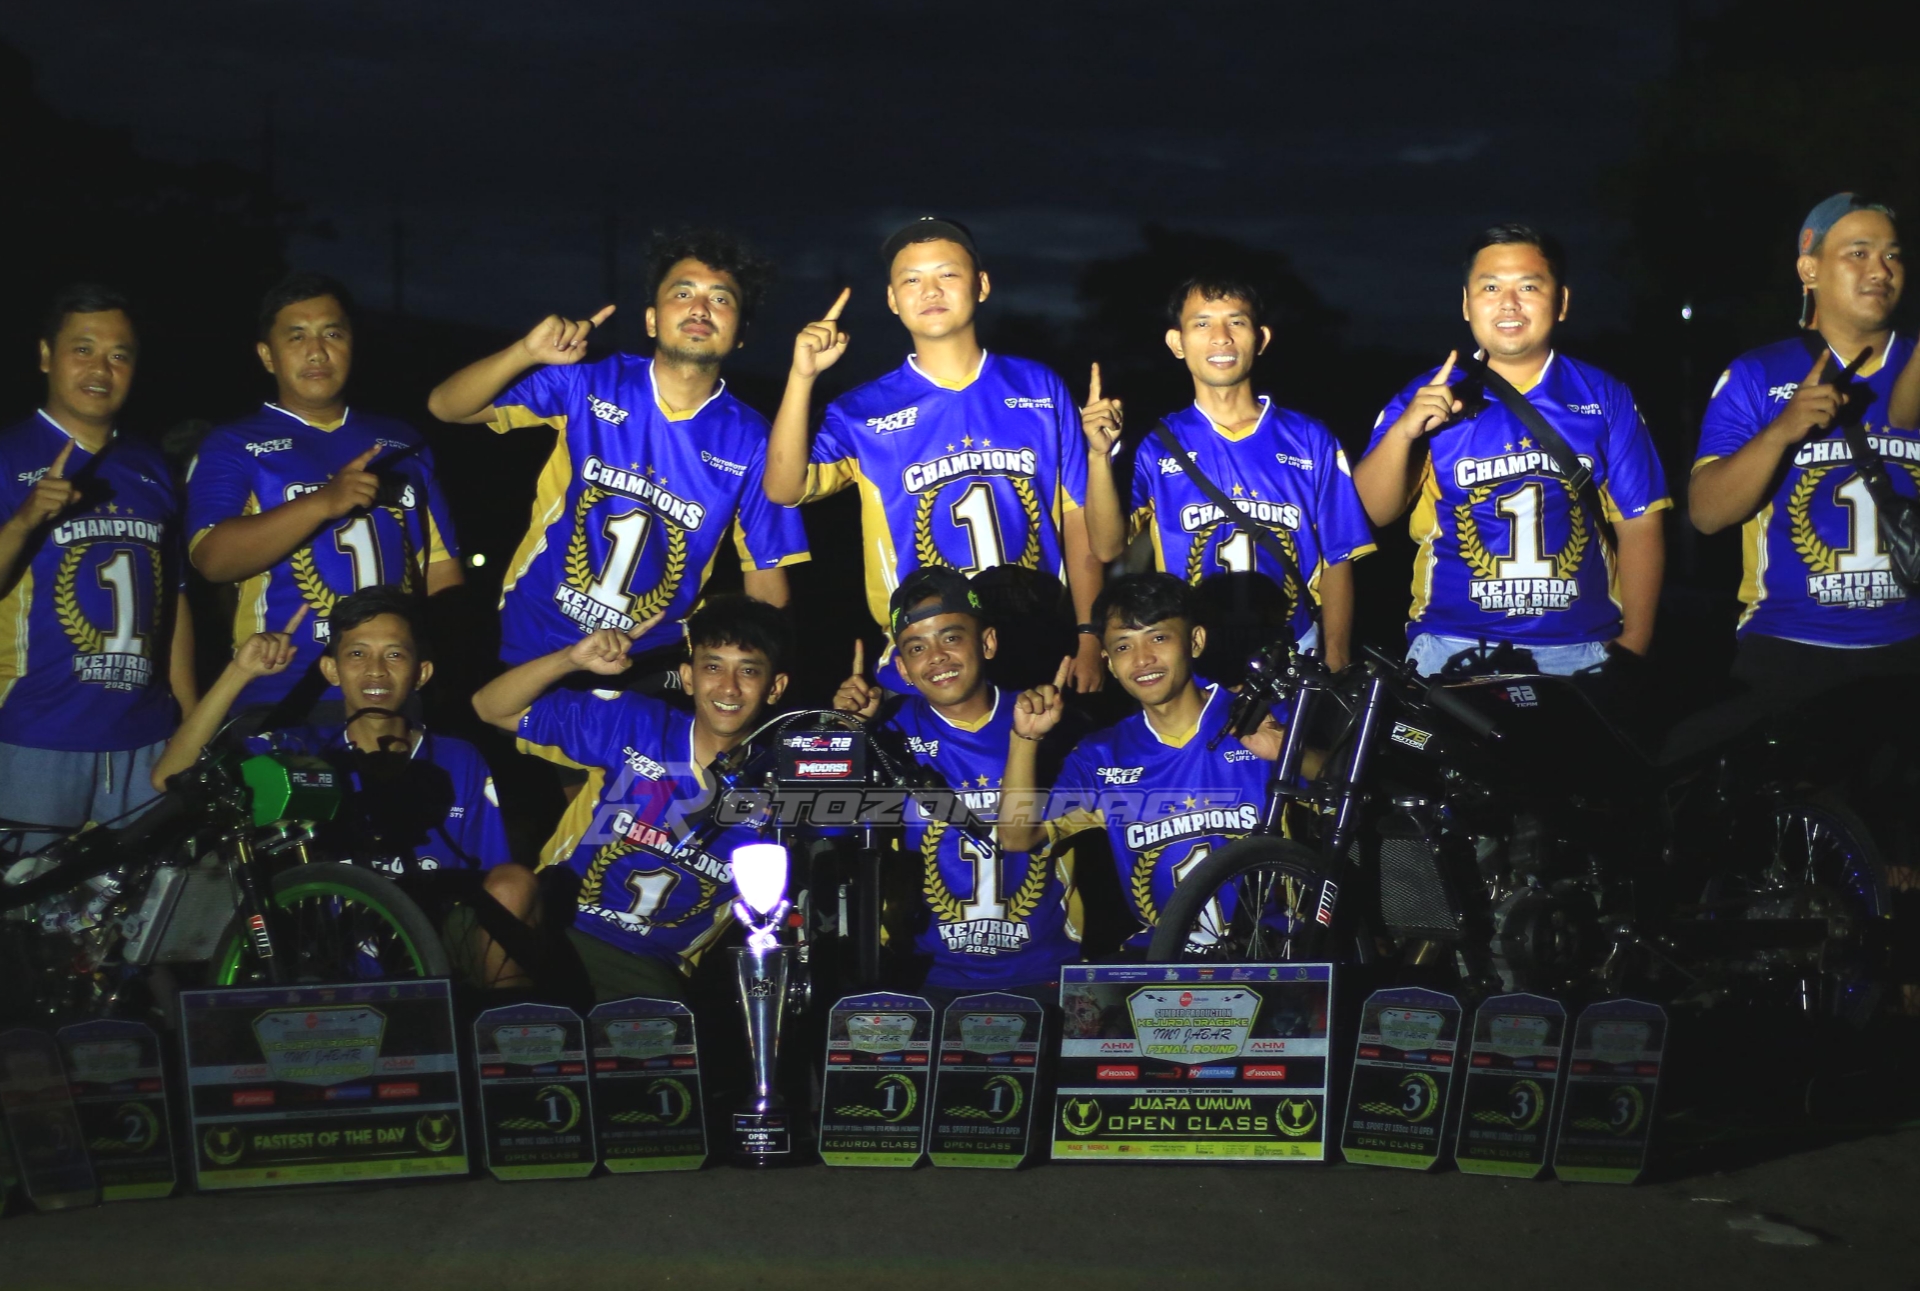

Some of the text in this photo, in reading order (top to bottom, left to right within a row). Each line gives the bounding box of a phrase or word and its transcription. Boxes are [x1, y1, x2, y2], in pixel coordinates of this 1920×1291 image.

[1768, 383, 1798, 397] SUP
[865, 406, 919, 427] SUPER
[874, 416, 917, 435] POLE
[254, 443, 294, 458] POLE
[1794, 436, 1920, 466] CHAPION
[17, 467, 64, 484] SUP
[709, 460, 745, 477] LIFE STYLE
[903, 449, 1037, 493] CHAMPIONS
[583, 457, 704, 531] CHAMPIONS
[1182, 500, 1300, 531] CHAPIONS
[1833, 472, 1893, 572] 1
[950, 481, 1008, 580] 1
[1495, 482, 1561, 579] 1
[333, 513, 386, 591] 1
[586, 507, 652, 613] 1
[1471, 579, 1579, 598] KEJURDA
[1818, 588, 1865, 603] DRAG
[96, 549, 144, 655] 1
[555, 584, 640, 631] KEJURD
[1480, 594, 1570, 609] DRAG BIKE
[1847, 600, 1884, 609] 2025
[561, 601, 598, 627] DRAG
[1507, 607, 1544, 617] 2025
[81, 667, 120, 681] DRAG
[104, 681, 133, 691] 2025
[1505, 685, 1538, 703] RB
[1390, 734, 1425, 750] MOTOR
[1392, 723, 1428, 743] P76
[622, 745, 666, 777] SUPER
[624, 756, 661, 782] POLE
[1096, 766, 1144, 777] SUPER
[1104, 774, 1139, 785] POLE
[1126, 805, 1257, 849] CHAMPIONS
[958, 834, 1010, 921] 1
[624, 866, 682, 924] 1
[938, 918, 1031, 940] KEJURDA
[947, 931, 1021, 951] DRAG BIKE
[965, 944, 997, 955] 2025
[1155, 1008, 1232, 1018] SUMBER PRODUCTION
[1137, 1018, 1249, 1028] KEJURDA DRAGBIKE
[1183, 1028, 1233, 1044] JABAR
[1145, 1044, 1239, 1055] FINAL ROUND
[656, 1089, 674, 1117] 1
[1129, 1097, 1252, 1110] JUARA UMUM
[1402, 1083, 1422, 1112] 3
[1511, 1091, 1529, 1120] 3
[545, 1096, 562, 1123] 1
[1611, 1097, 1629, 1126] 3
[123, 1115, 145, 1143] 2
[952, 1125, 970, 1134] SPORT
[1005, 1126, 1021, 1135] OPEN
[1108, 1116, 1269, 1131] OPEN CLASS
[1366, 1122, 1384, 1131] SPORT
[1419, 1126, 1434, 1136] OPEN
[254, 1127, 406, 1150] FASTEST OF THE DAY
[825, 1140, 918, 1149] KEJURDA CLASS
[943, 1141, 1012, 1150] OPEN CLASS
[1357, 1137, 1424, 1151] OPEN CLASS
[504, 1151, 580, 1162] OPEN CLASS
[606, 1143, 700, 1155] KEJURDA CLASS
